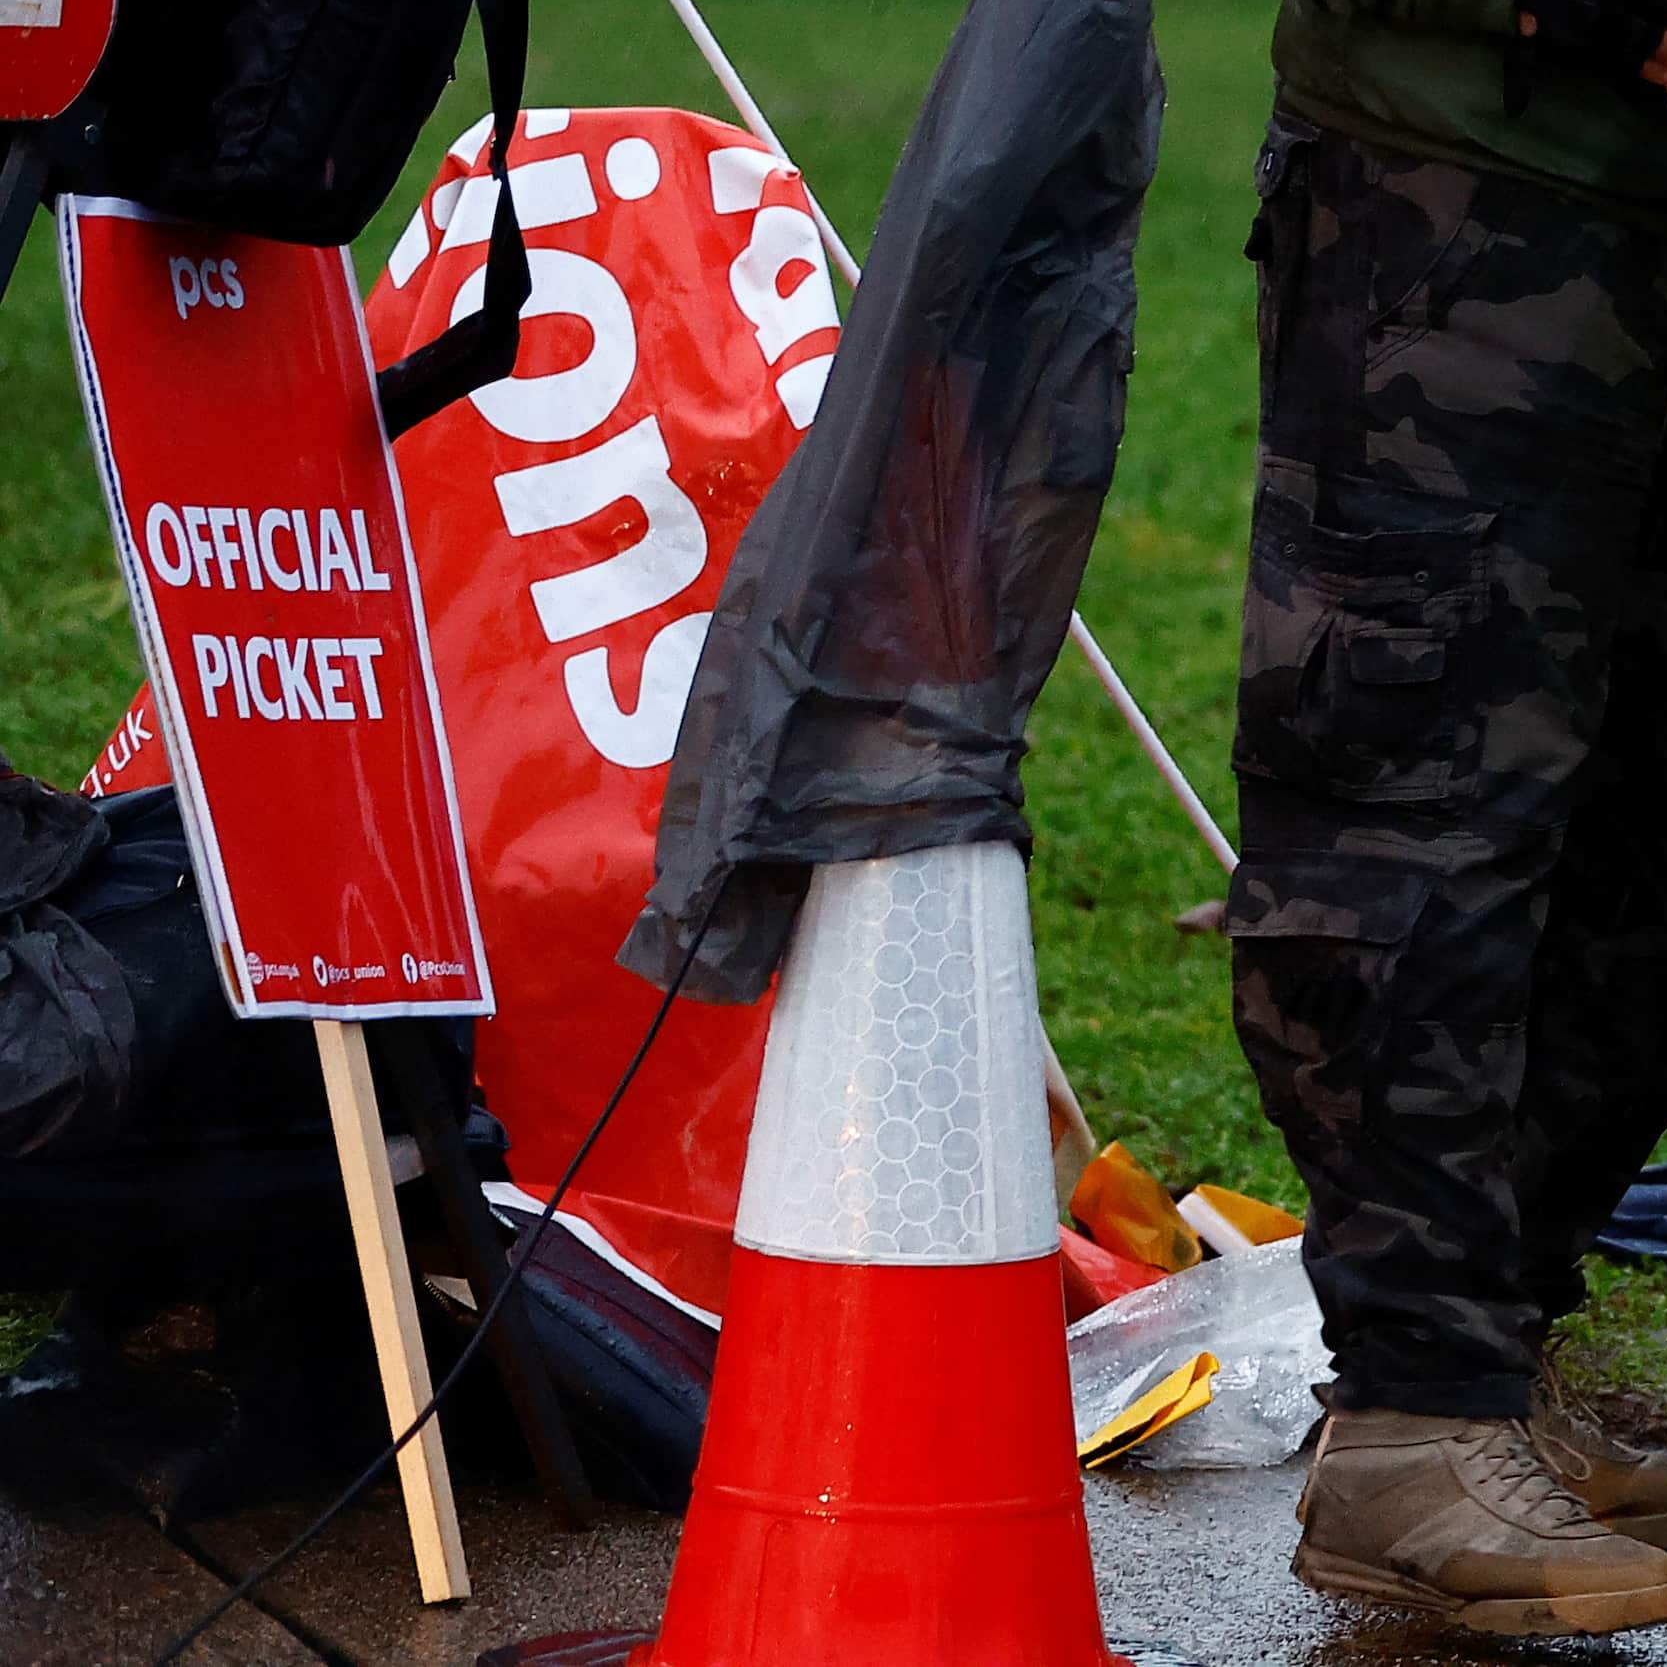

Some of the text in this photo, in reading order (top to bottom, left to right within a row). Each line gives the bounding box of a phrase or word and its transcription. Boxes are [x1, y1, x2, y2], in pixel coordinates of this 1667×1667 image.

[169, 255, 246, 321] pcs
[144, 501, 391, 594] OFFICIAL
[190, 632, 384, 722] PICKET
